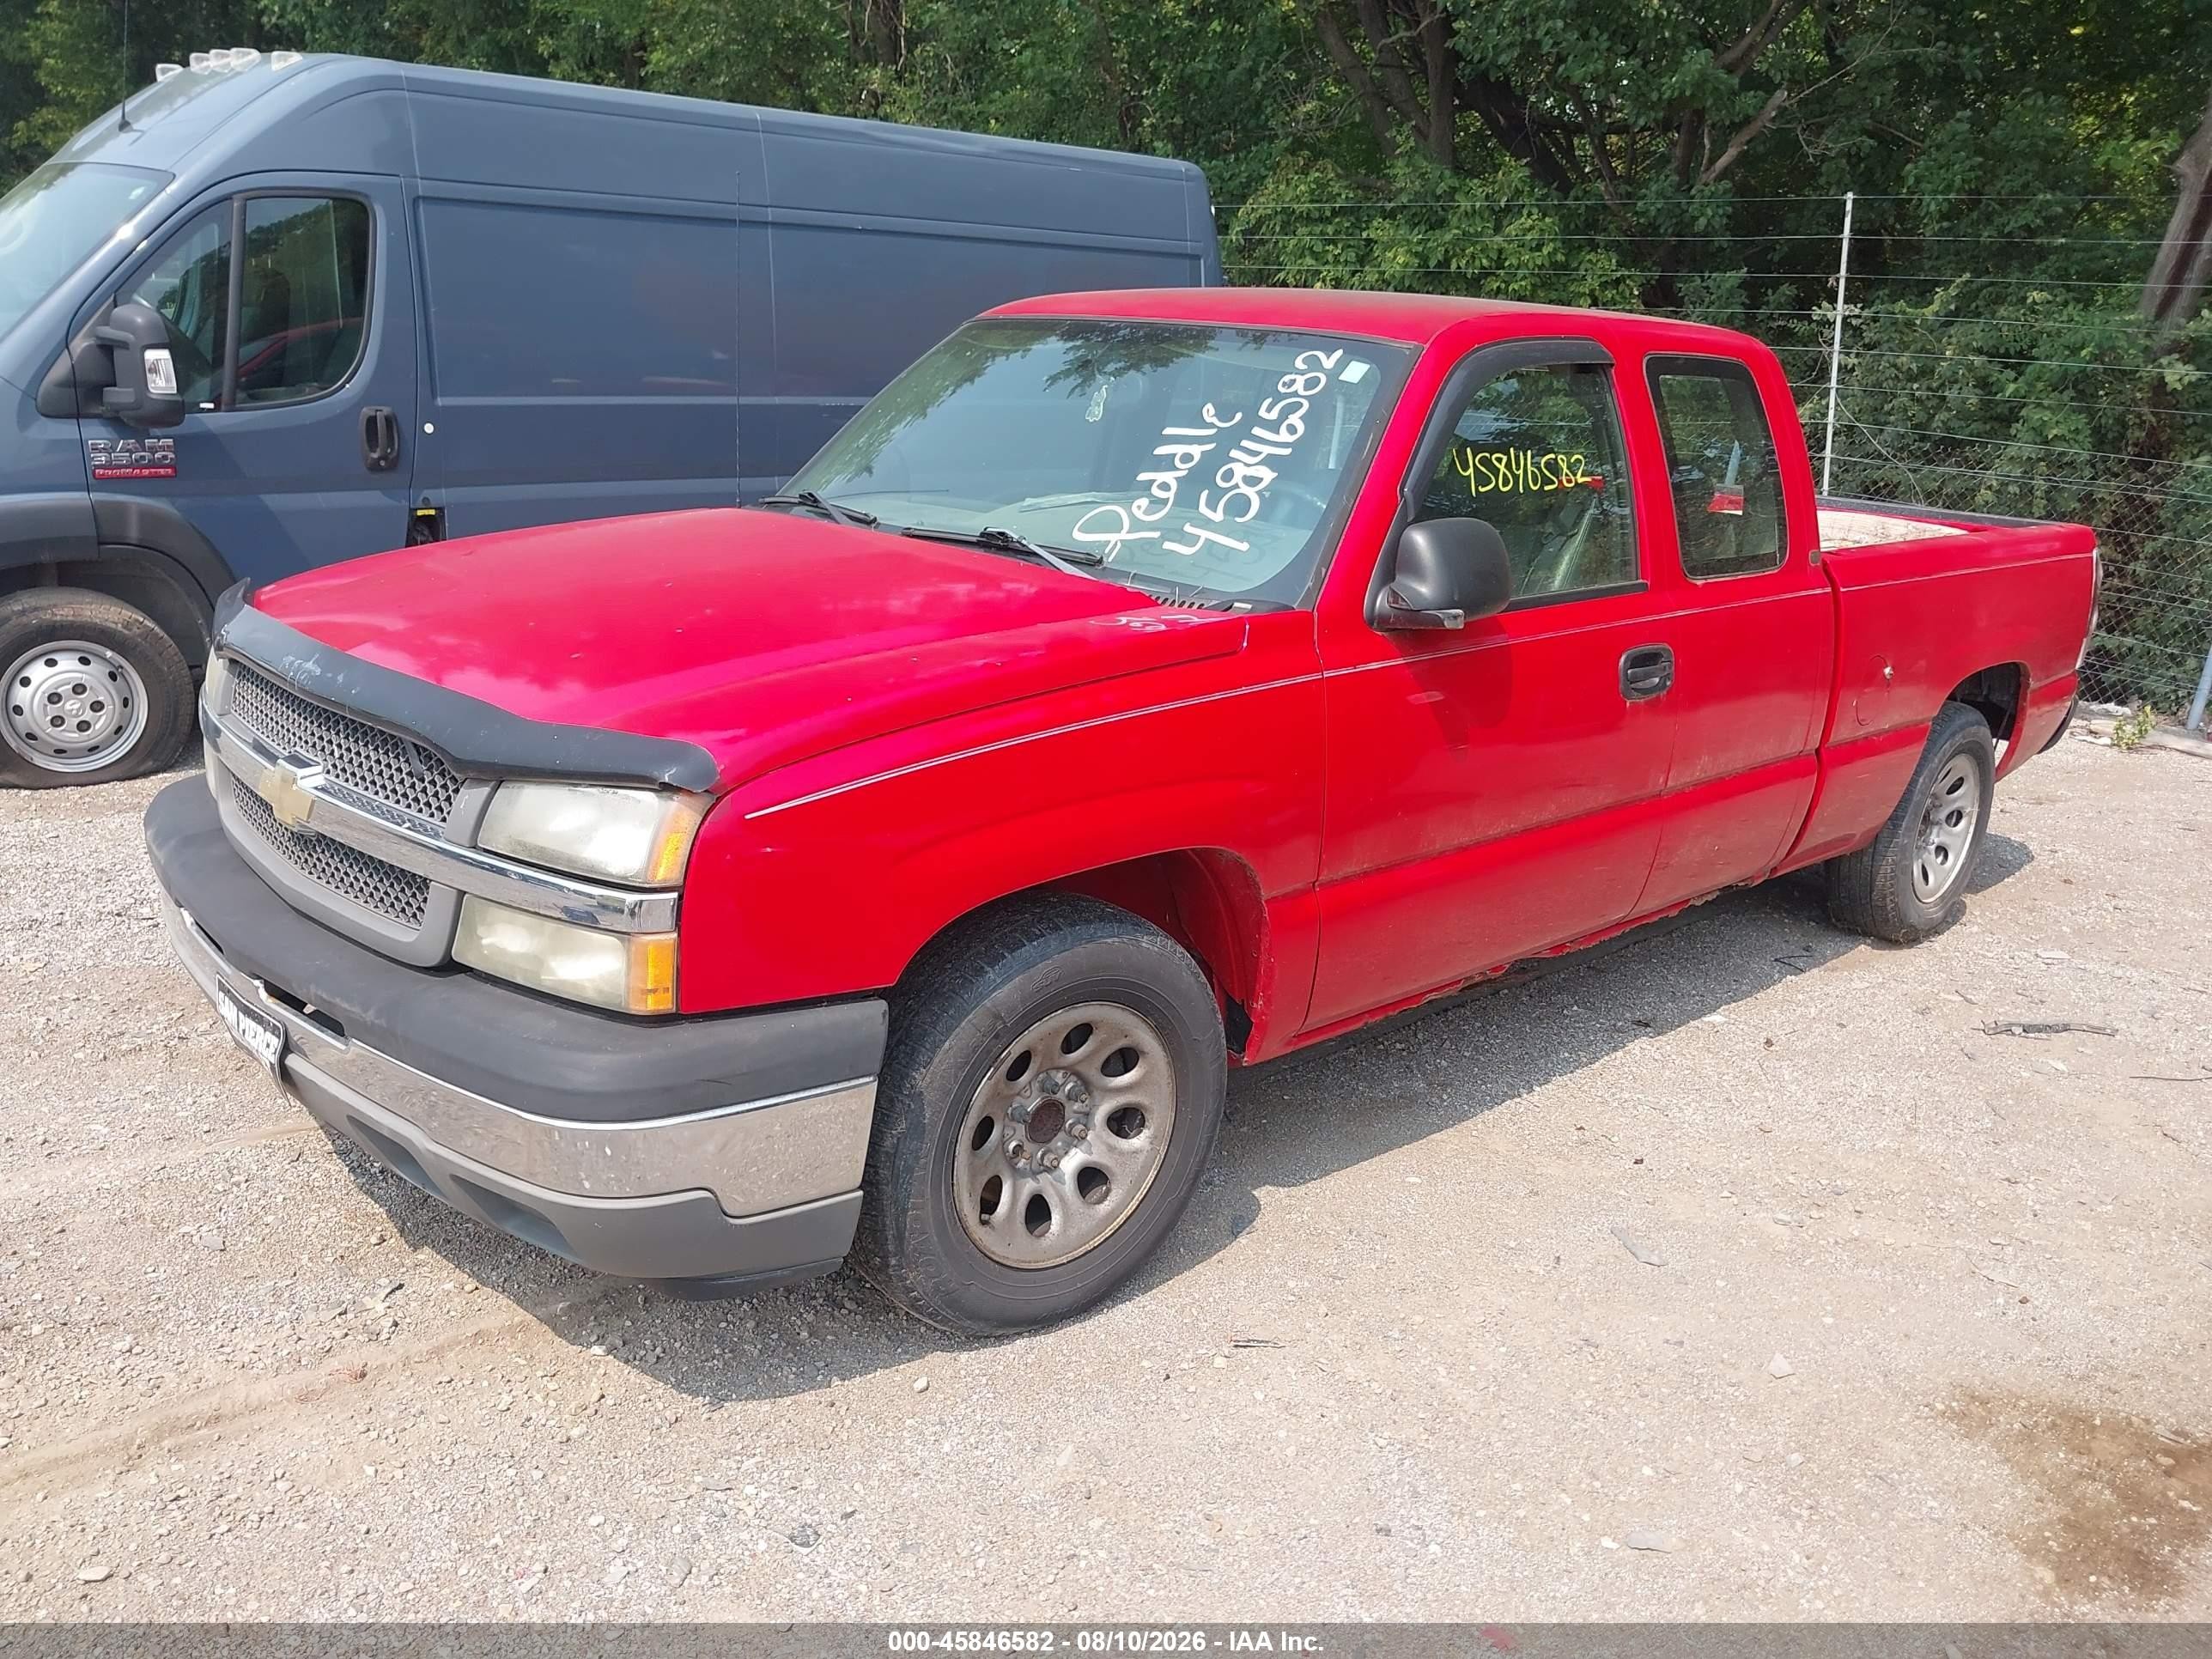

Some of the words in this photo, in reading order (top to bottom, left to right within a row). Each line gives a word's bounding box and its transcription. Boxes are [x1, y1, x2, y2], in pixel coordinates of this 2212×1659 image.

[88, 439, 175, 453] RAM
[90, 452, 175, 465] 3500
[1162, 349, 1344, 556] 45846582
[1452, 447, 1592, 498] 45846582
[238, 1010, 279, 1065] PIERCE
